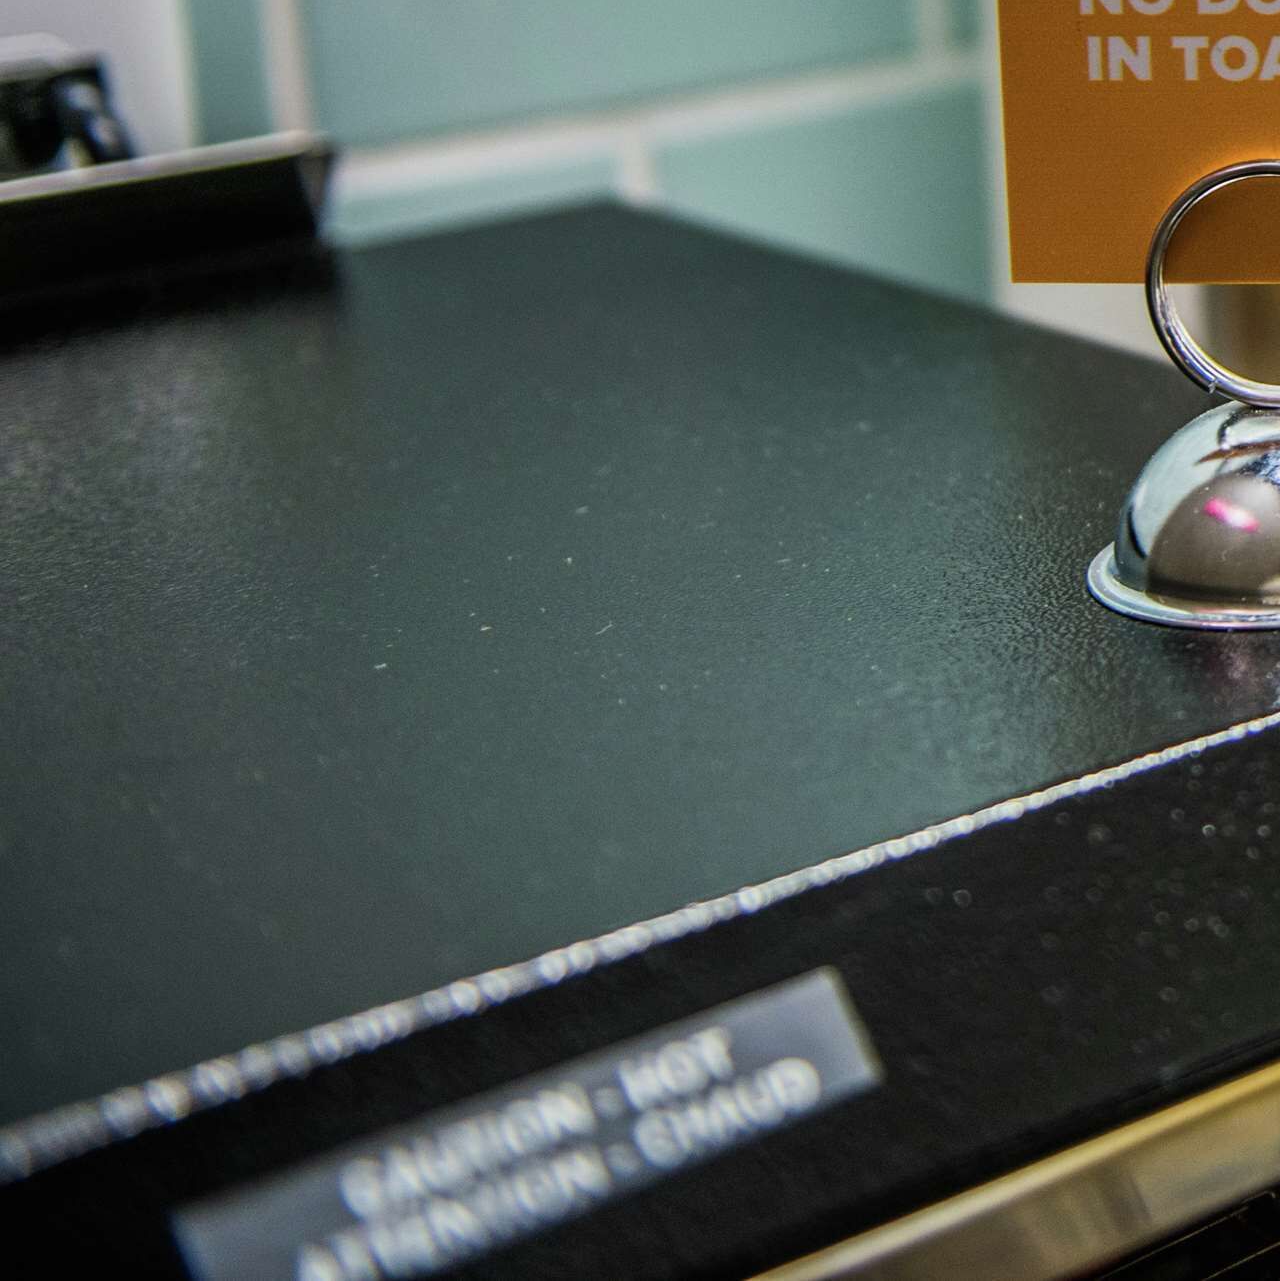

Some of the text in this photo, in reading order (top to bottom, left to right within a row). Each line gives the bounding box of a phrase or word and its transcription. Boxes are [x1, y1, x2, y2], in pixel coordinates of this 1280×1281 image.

[1087, 35, 1152, 81] IN
[338, 1026, 734, 1221] CAUTION HOT
[632, 1056, 822, 1169] CHAUD
